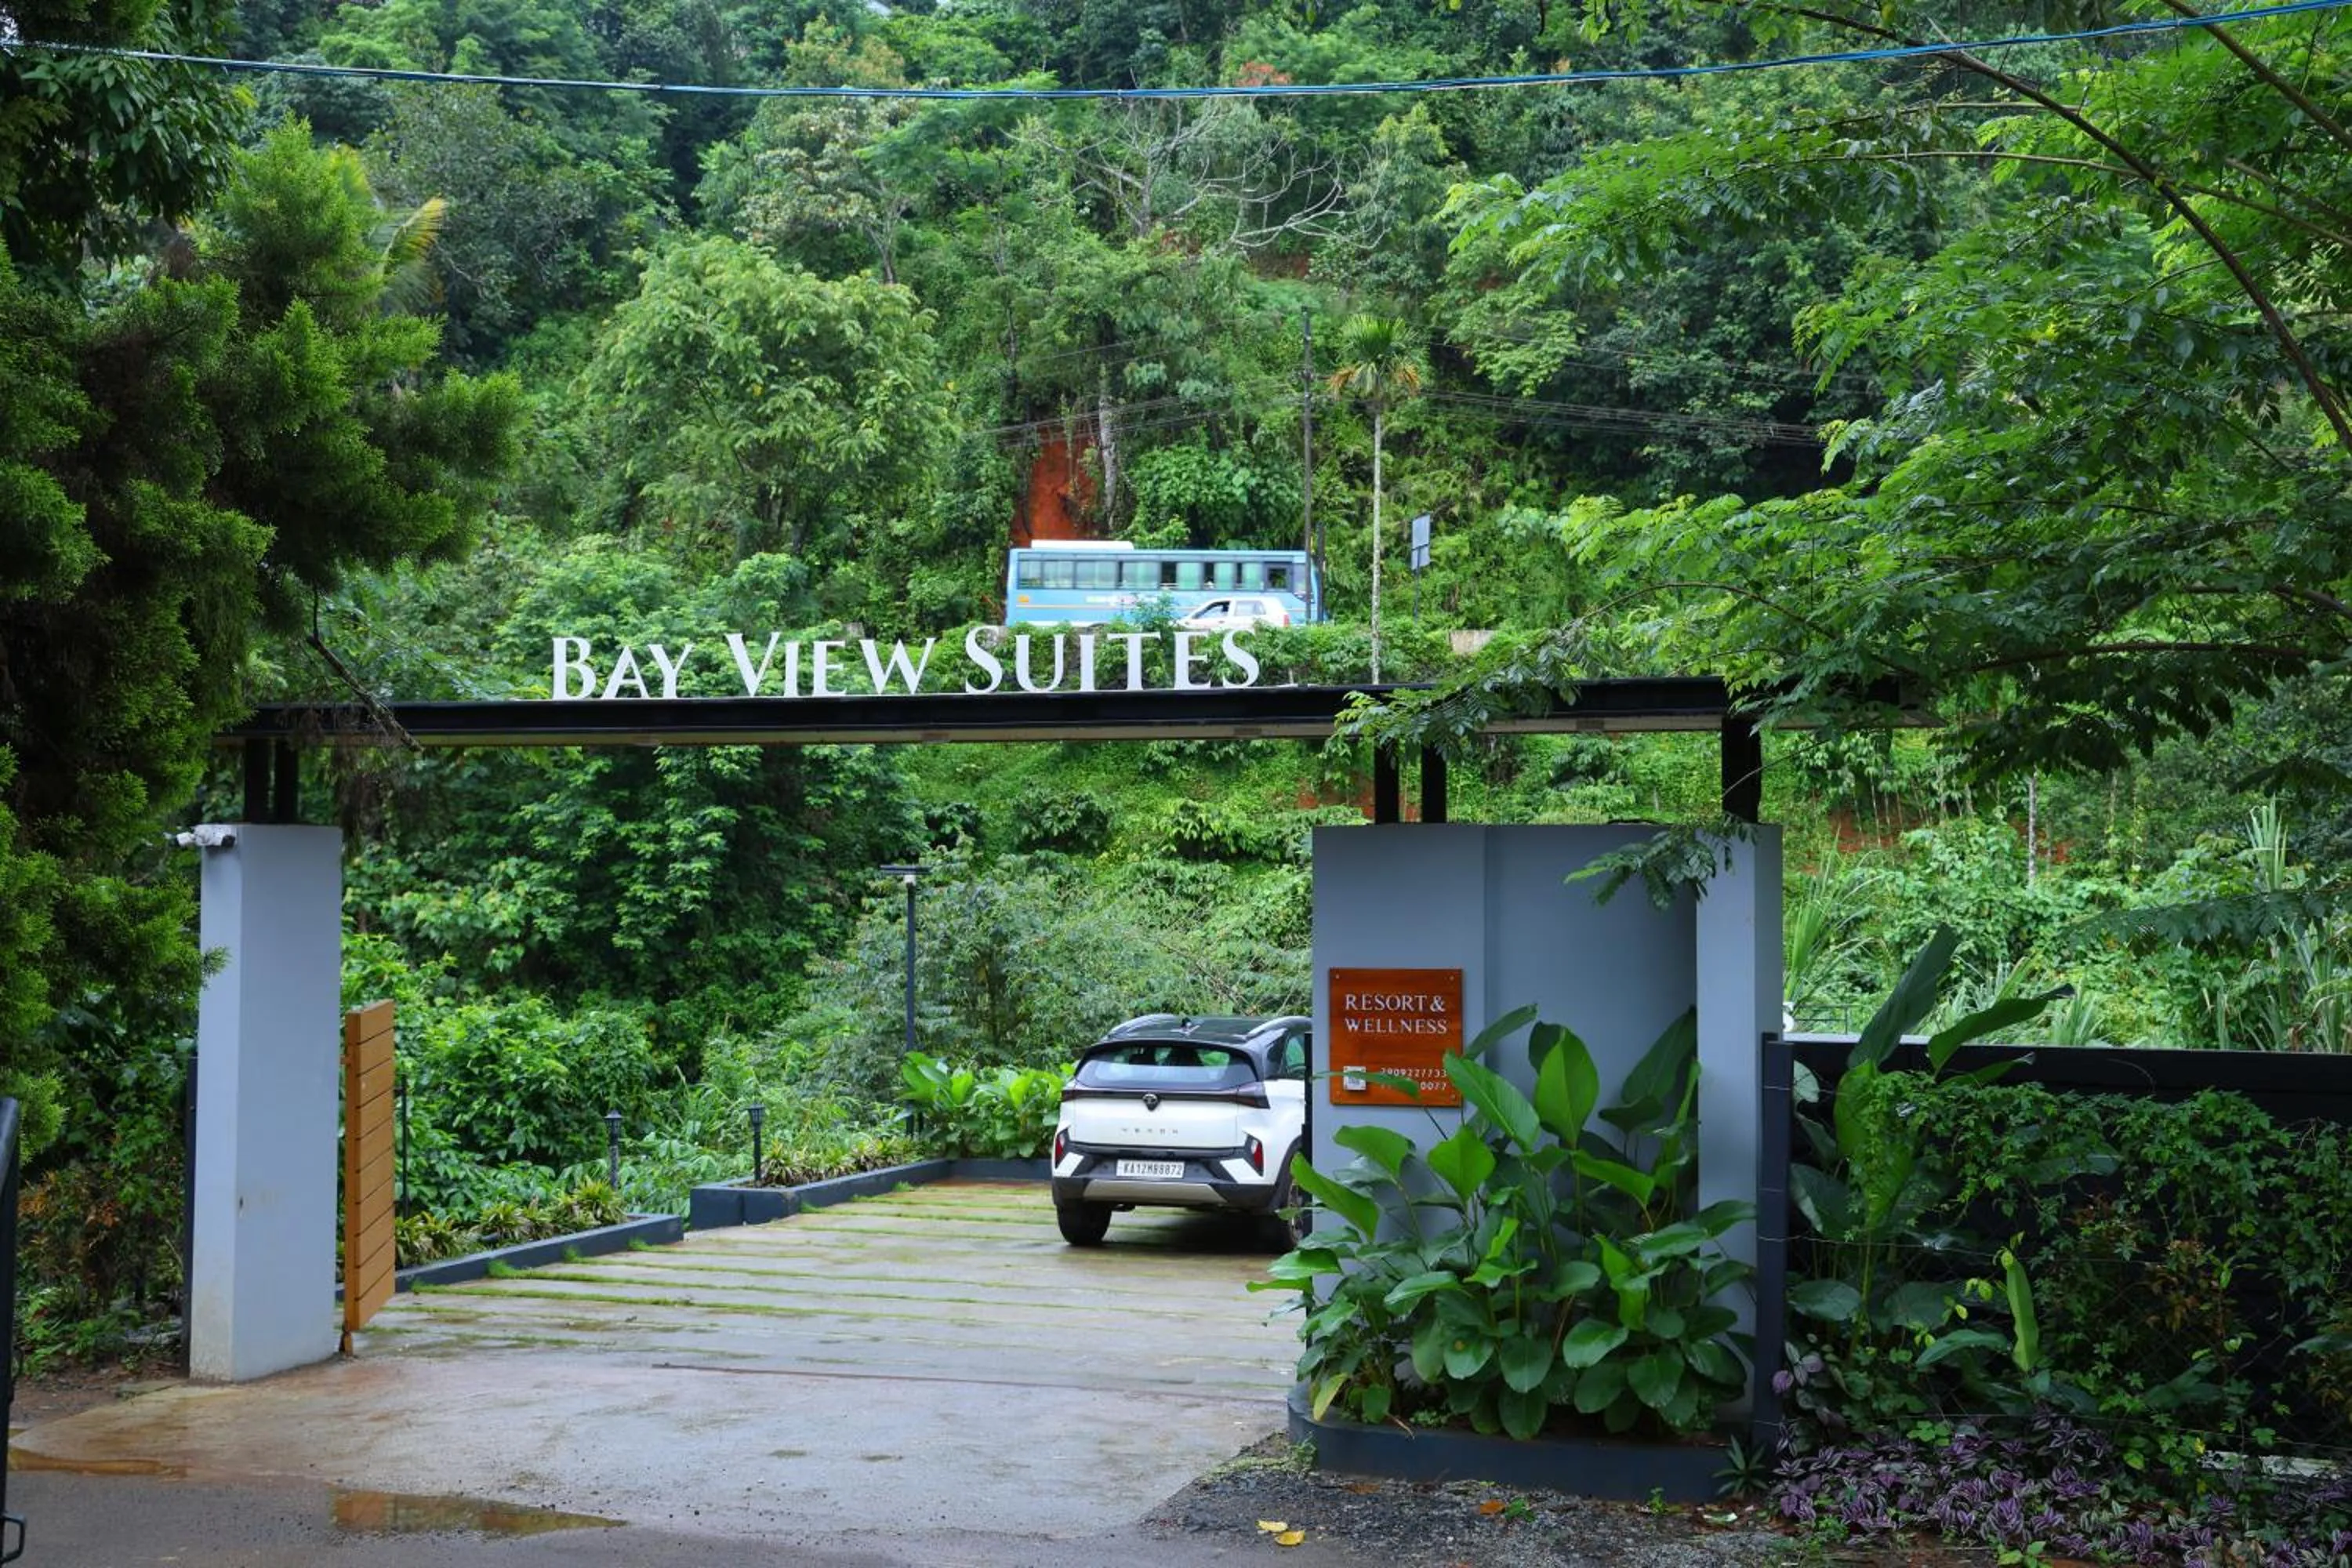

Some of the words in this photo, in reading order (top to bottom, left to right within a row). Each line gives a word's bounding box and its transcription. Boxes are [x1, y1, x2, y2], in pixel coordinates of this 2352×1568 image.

[552, 637, 695, 700] BAY
[724, 632, 935, 697] VIEW
[965, 625, 1260, 694] SUITES
[1345, 993, 1427, 1011] RESORT
[1345, 1018, 1447, 1034] WELLNESS
